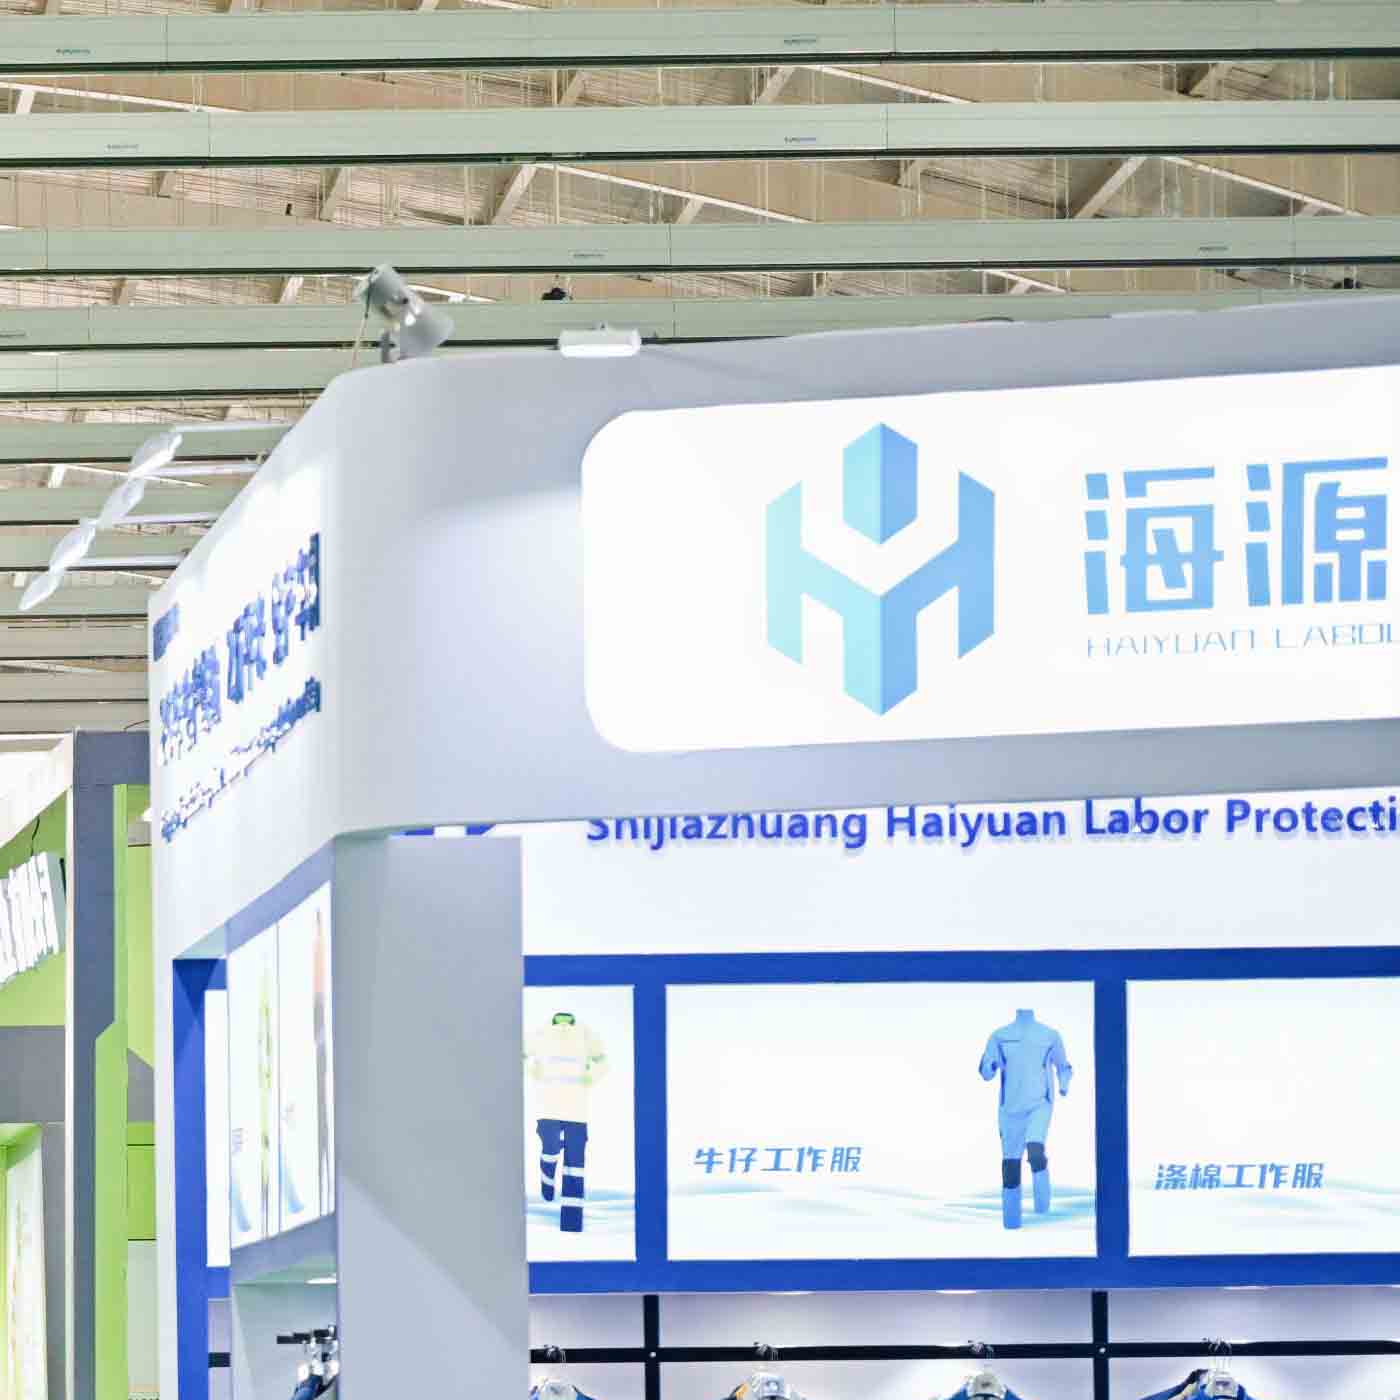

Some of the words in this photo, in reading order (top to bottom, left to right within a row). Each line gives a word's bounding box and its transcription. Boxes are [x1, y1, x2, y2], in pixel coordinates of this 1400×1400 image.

[1085, 456, 1389, 615] 海源
[886, 802, 1067, 848] Haiyuan
[1084, 796, 1209, 836] Labor
[1225, 795, 1397, 833] Protecti
[693, 1145, 863, 1175] 牛仔工作服
[1154, 1161, 1325, 1191] 涤棉工作服
